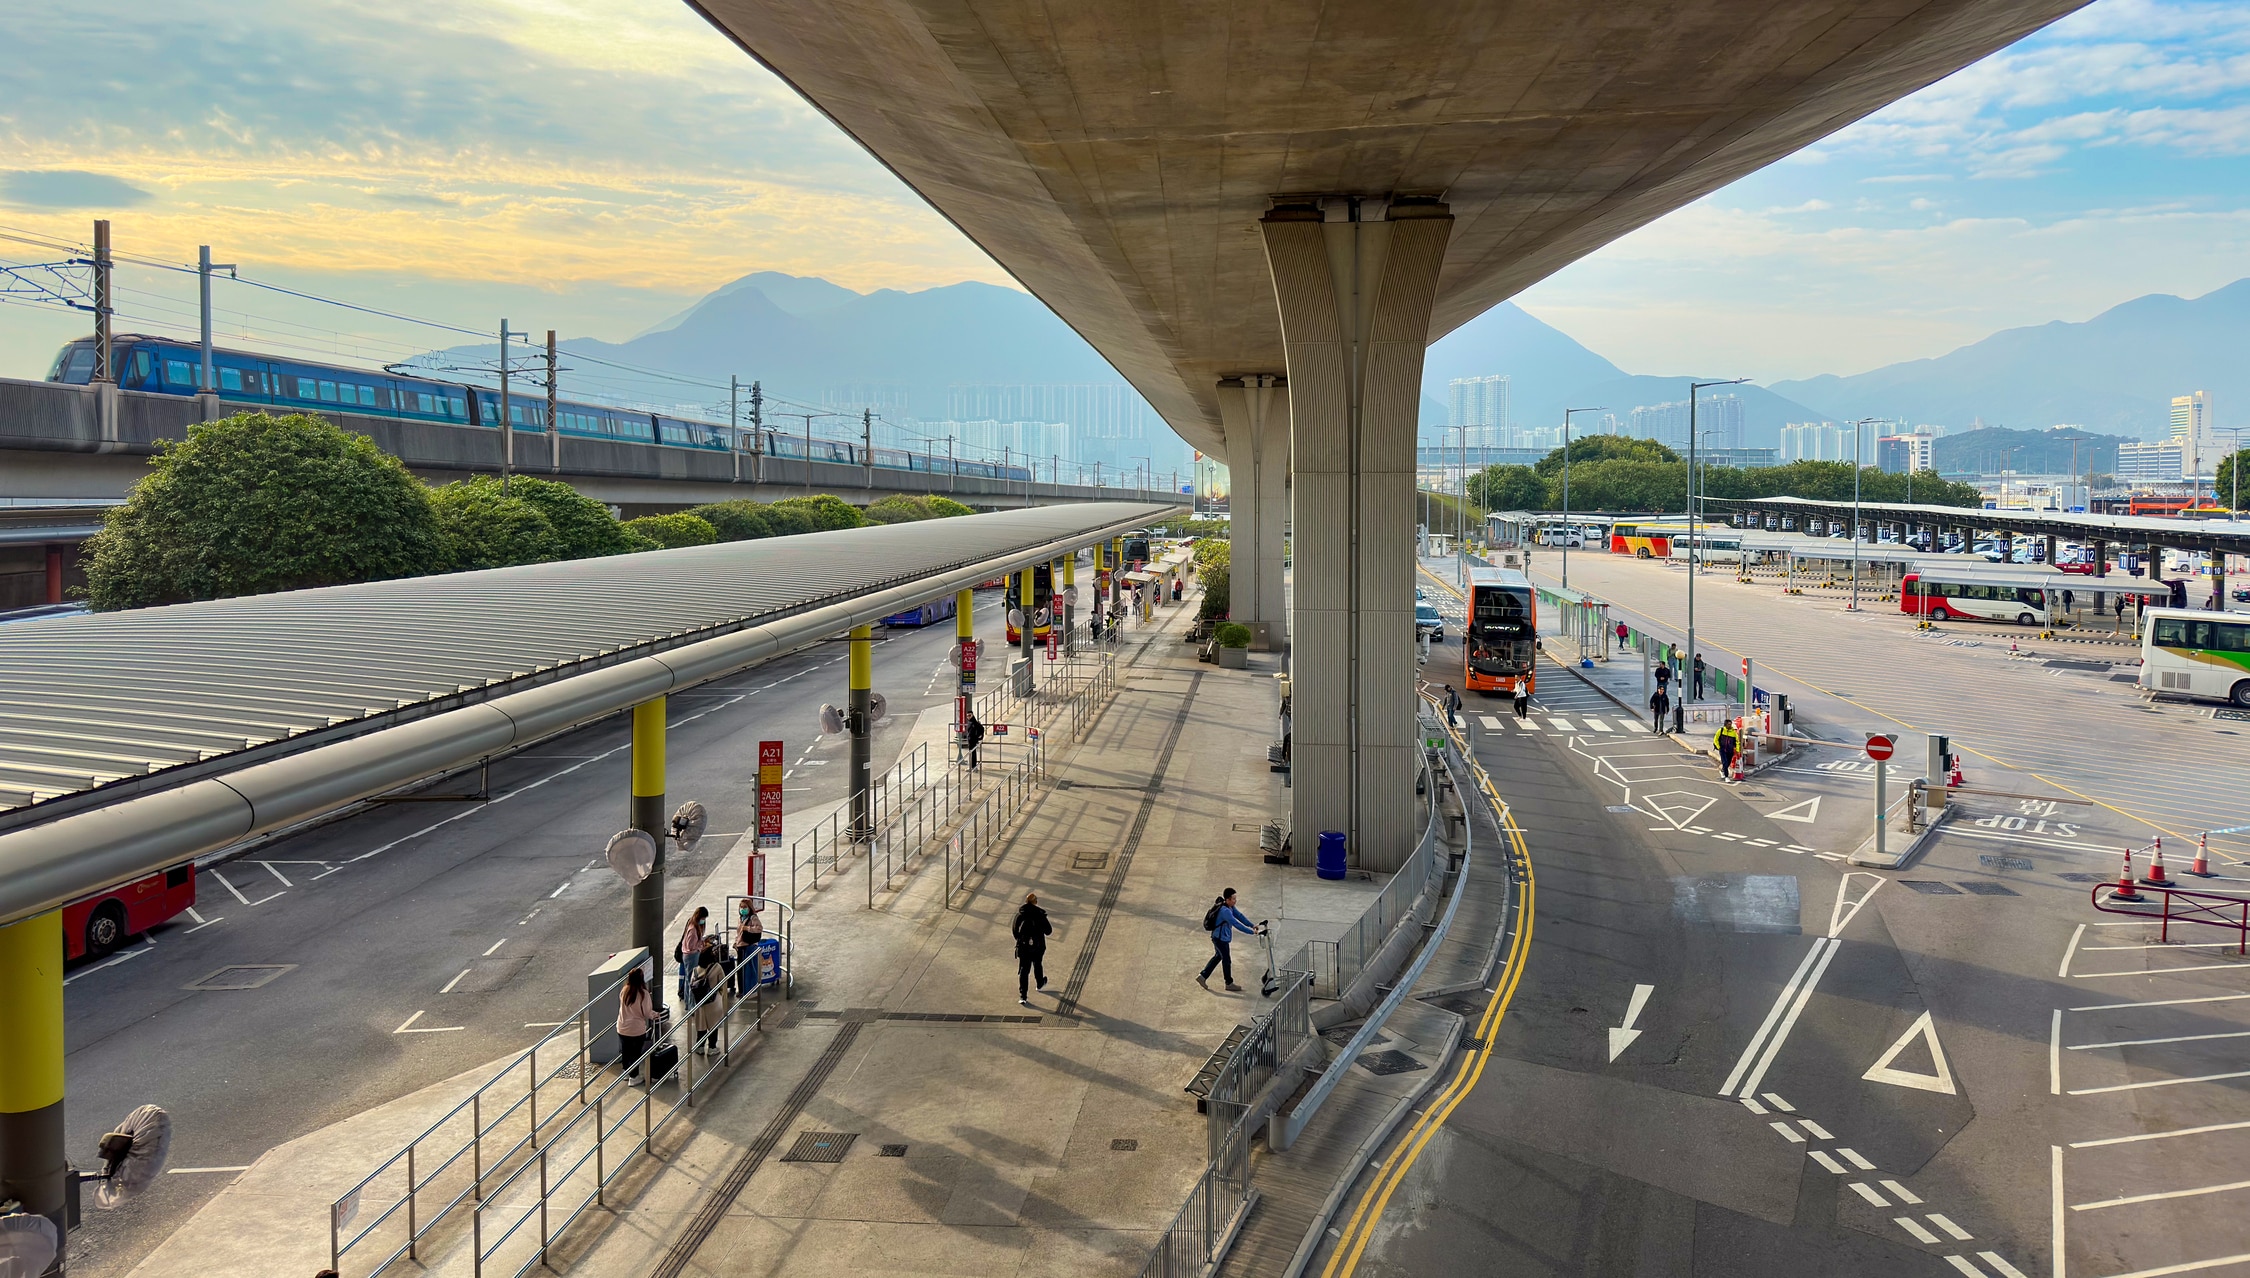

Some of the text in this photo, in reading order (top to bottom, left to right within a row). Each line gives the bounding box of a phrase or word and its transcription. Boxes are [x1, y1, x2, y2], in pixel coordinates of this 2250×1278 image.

[1814, 522, 1821, 530] 20
[1833, 524, 1840, 532] 19
[1860, 528, 1867, 536] 18
[1883, 529, 1890, 538] 17
[1923, 532, 1930, 541] 16
[1950, 535, 1958, 545] 15
[2000, 541, 2009, 551] 14
[2036, 545, 2043, 556] 13
[2078, 550, 2085, 560] 12
[2086, 550, 2095, 561] 12
[2120, 556, 2126, 567] 11
[2130, 556, 2137, 568] 11
[762, 748, 780, 757] A21
[1816, 760, 1902, 775] STOP
[1975, 815, 2081, 837] STOP
